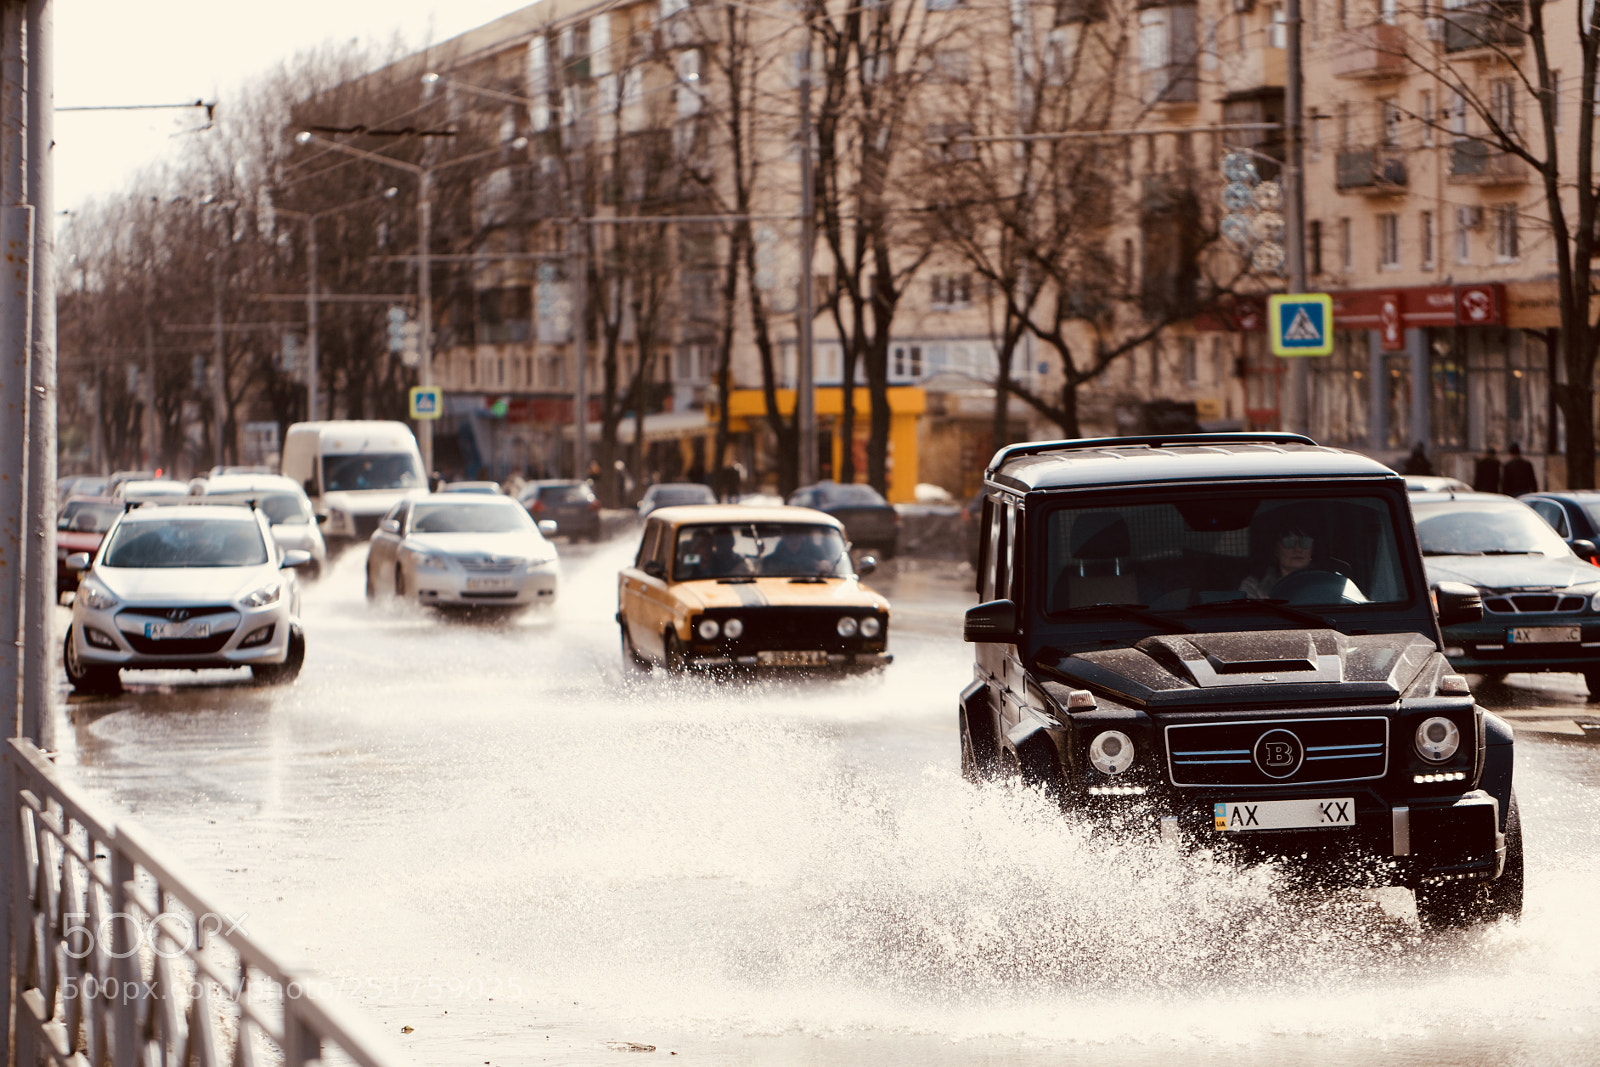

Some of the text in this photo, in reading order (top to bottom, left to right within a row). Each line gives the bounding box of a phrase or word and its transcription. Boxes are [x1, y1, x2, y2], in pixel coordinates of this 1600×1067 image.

[1515, 630, 1530, 641] AX
[1265, 742, 1294, 766] B
[1230, 801, 1349, 826] AX KX
